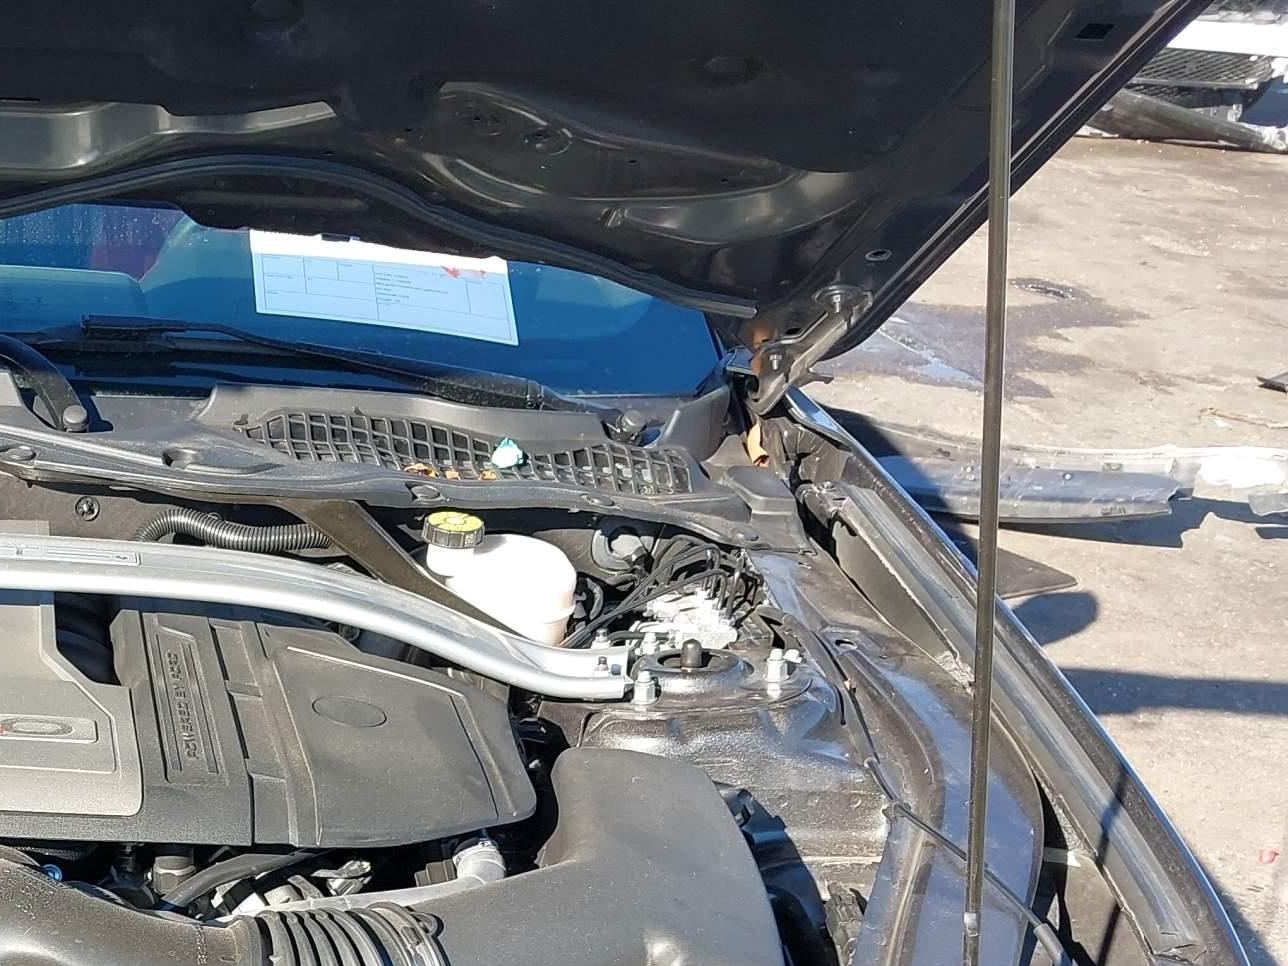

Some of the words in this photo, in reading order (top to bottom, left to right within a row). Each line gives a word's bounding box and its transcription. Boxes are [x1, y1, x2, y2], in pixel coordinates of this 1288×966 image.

[166, 650, 182, 680] FORD
[173, 684, 187, 699] BY
[177, 701, 199, 760] POWERED
